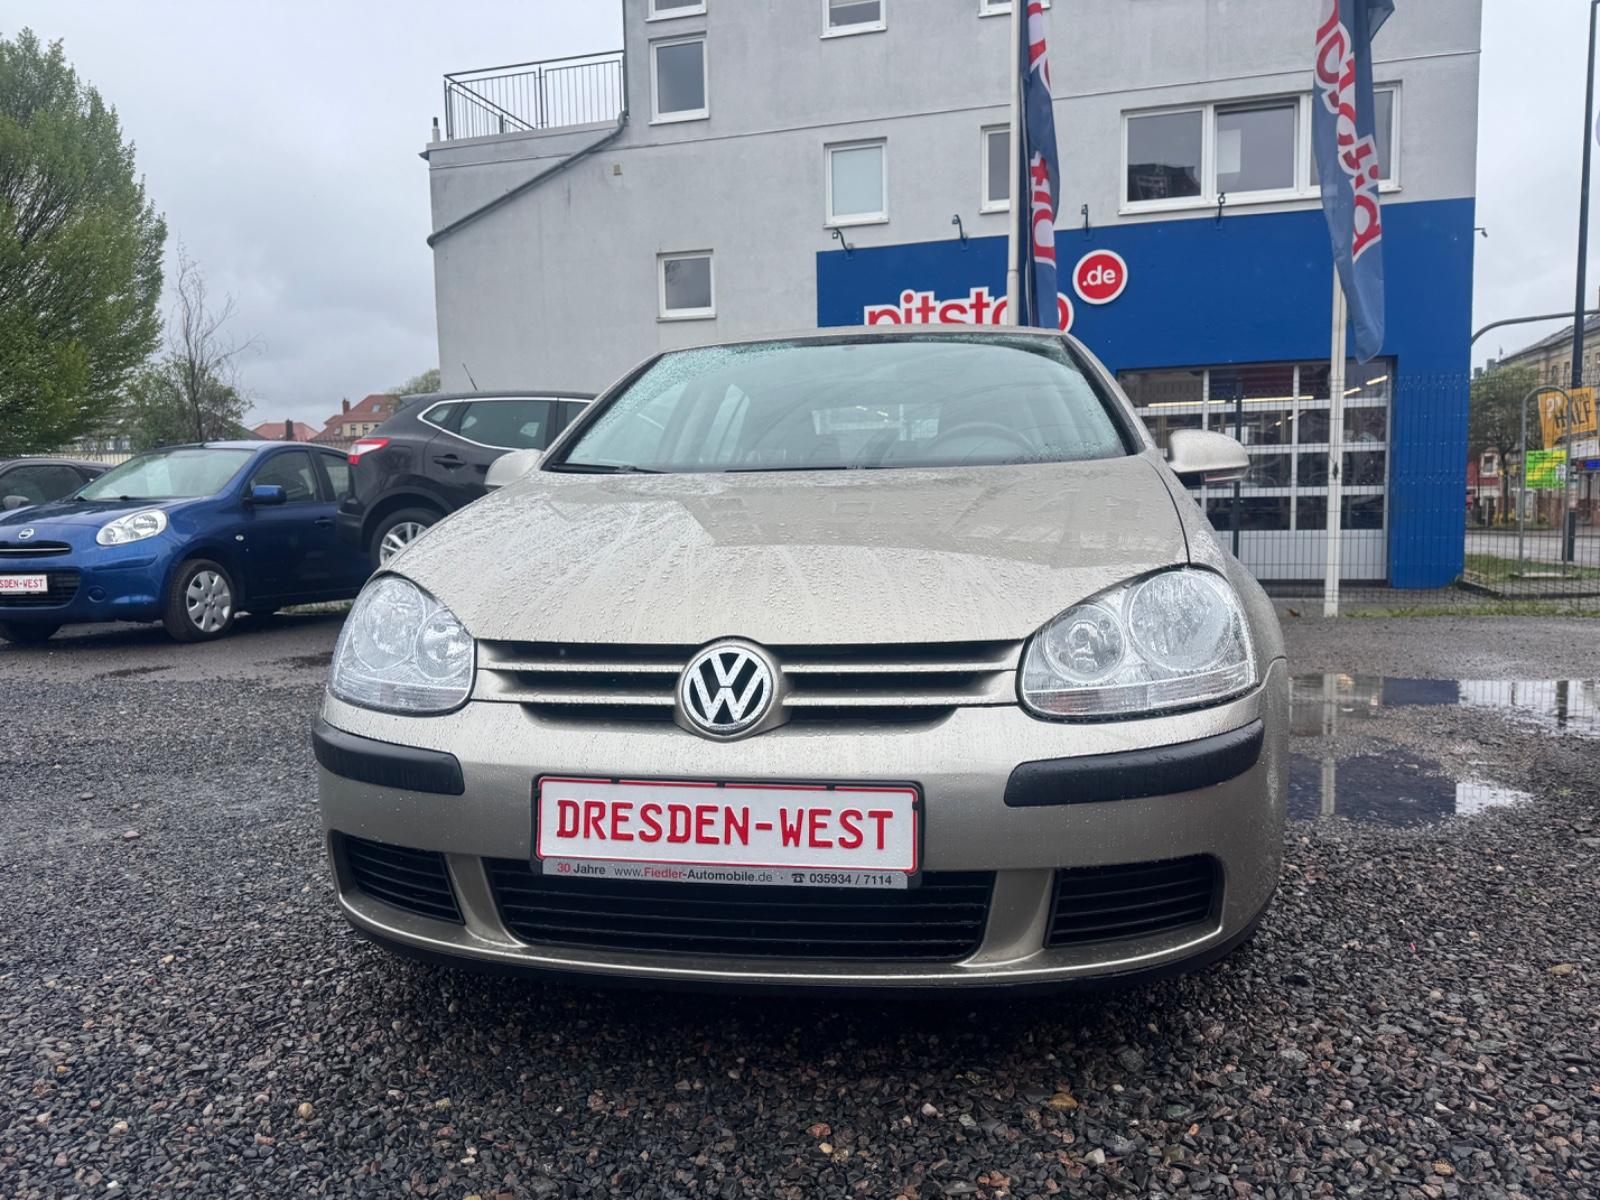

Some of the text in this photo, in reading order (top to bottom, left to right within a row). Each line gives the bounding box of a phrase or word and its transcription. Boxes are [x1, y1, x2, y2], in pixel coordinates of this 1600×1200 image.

[1081, 264, 1116, 287] .de
[556, 799, 894, 850] DRESDEN-WEST
[556, 863, 571, 873] 30
[573, 864, 606, 875] Jahre
[613, 866, 773, 883] www.Fiedler-Automobile.de
[810, 873, 852, 884] 035934
[864, 874, 892, 885] 7114
